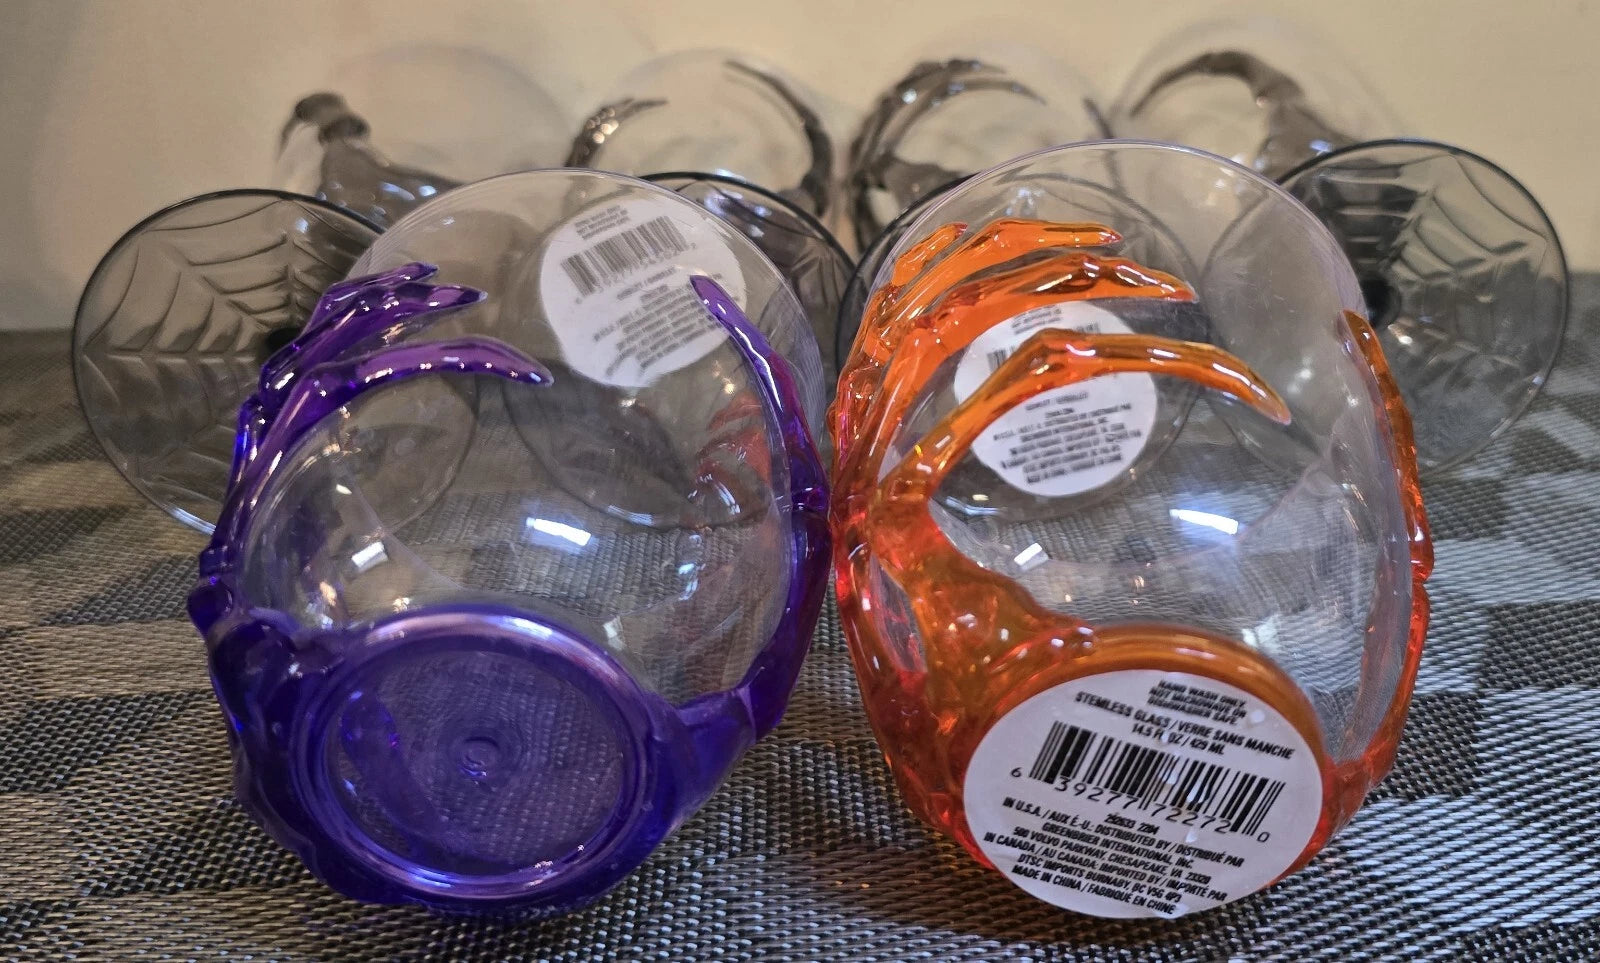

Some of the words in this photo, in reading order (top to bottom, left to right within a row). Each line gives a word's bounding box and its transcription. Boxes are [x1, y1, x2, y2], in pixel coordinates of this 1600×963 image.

[1075, 691, 1134, 717] STEMLESS
[1134, 709, 1172, 728] GLASS
[1178, 720, 1214, 738] VERRE
[1213, 730, 1245, 746] SANS
[1244, 738, 1296, 760] MANCHE
[1168, 732, 1184, 744] OZ
[1208, 742, 1226, 755] ML
[1002, 796, 1016, 808] IN
[1048, 811, 1072, 824] AUX
[1094, 824, 1156, 847] DISTRIBUTED
[1156, 840, 1172, 850] BY
[1176, 844, 1226, 863] DISTRIBUÉ
[1224, 855, 1245, 868] PAR
[1030, 830, 1060, 846] VOLVO
[1060, 840, 1107, 860] PARKWAY,
[1108, 853, 1168, 876] CHESAPEAKE,
[1170, 868, 1183, 878] VA
[1042, 822, 1100, 846] GREENBRIER
[1175, 858, 1195, 869] INC.
[983, 832, 996, 842] IN
[996, 835, 1036, 853] CANADA
[1041, 847, 1058, 858] AU
[1098, 863, 1147, 882] IMPORTED
[1146, 874, 1162, 885] BY
[1166, 879, 1210, 898] IMPORTÉ
[1206, 890, 1228, 902] PAR
[1011, 864, 1042, 880] MADE
[1040, 872, 1053, 883] IN
[1052, 875, 1082, 891] CHINA
[1132, 895, 1148, 906] EN
[1146, 899, 1177, 914] CHINE
[1017, 853, 1044, 867] DTSC
[1042, 860, 1086, 878] IMPORTS
[1084, 870, 1130, 891] BURNABY,
[1132, 882, 1148, 894] BC
